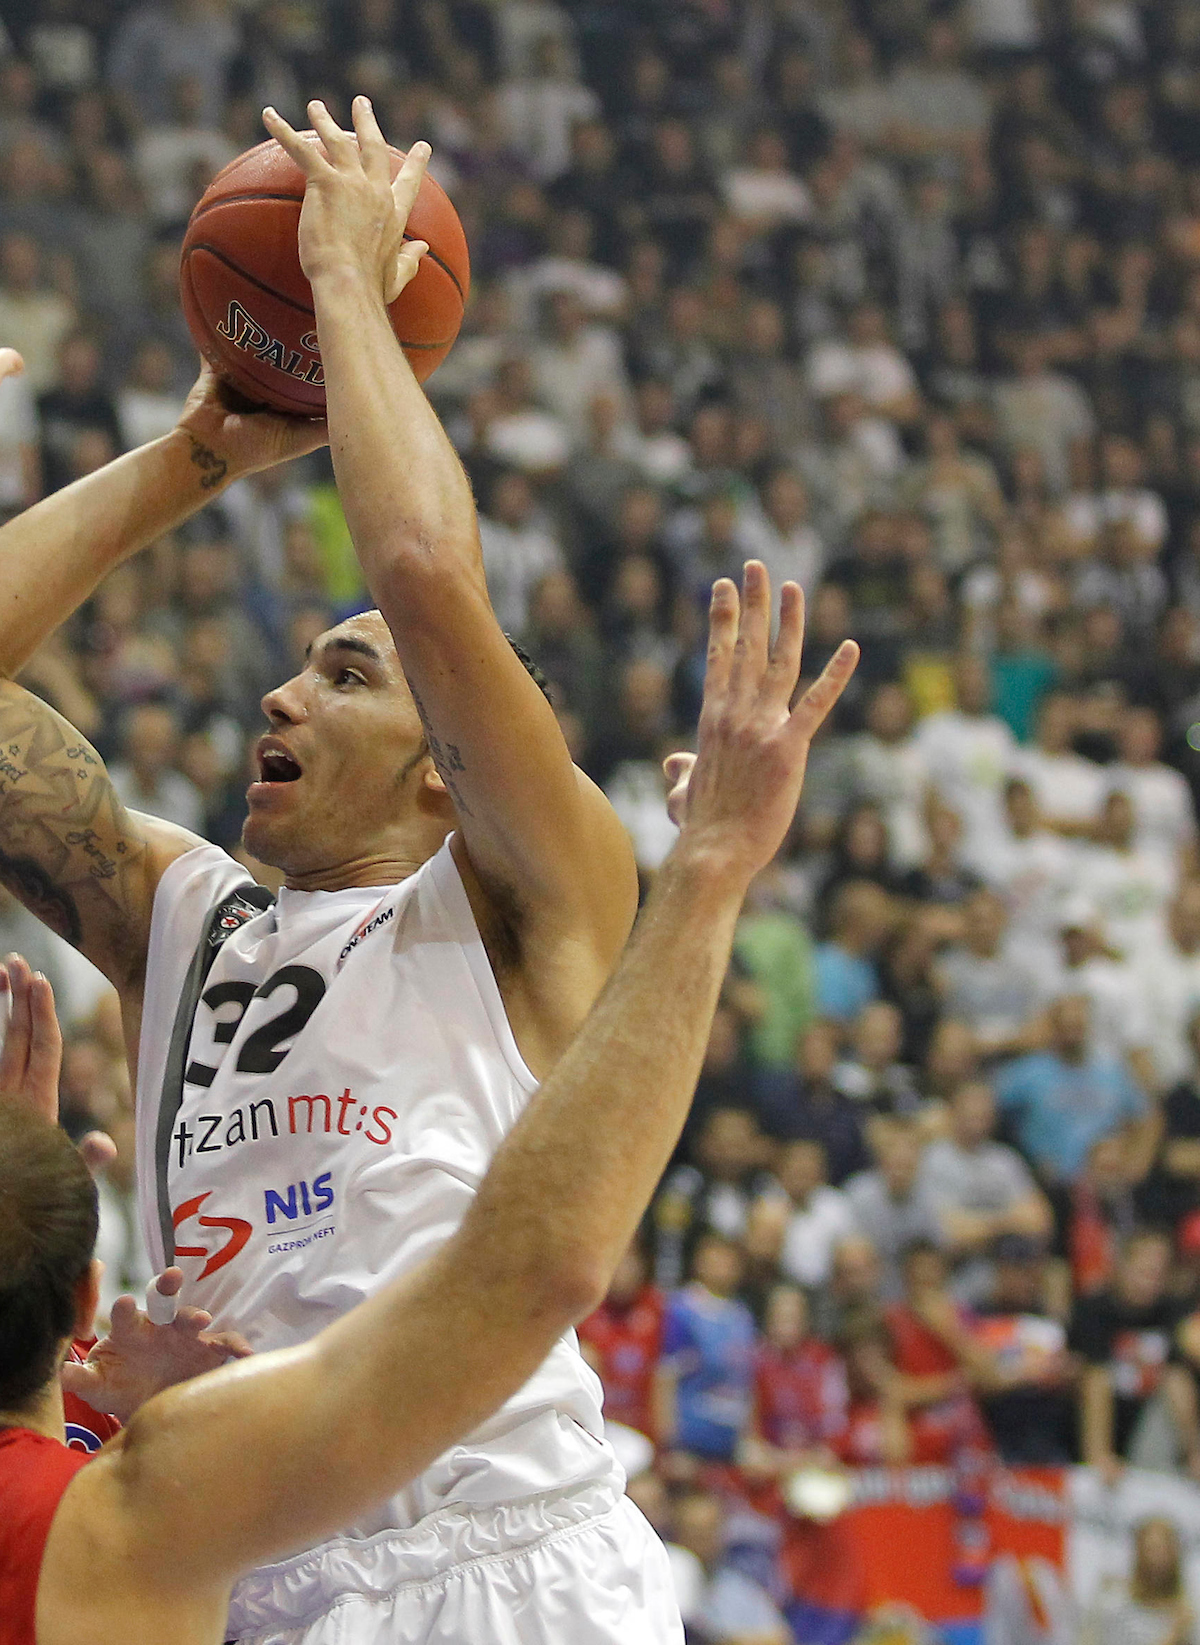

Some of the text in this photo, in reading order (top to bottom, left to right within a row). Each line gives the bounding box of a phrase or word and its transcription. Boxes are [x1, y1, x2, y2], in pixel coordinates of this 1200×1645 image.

[216, 300, 326, 387] SPALD
[185, 965, 327, 1088] 32
[264, 1171, 334, 1224] NIS
